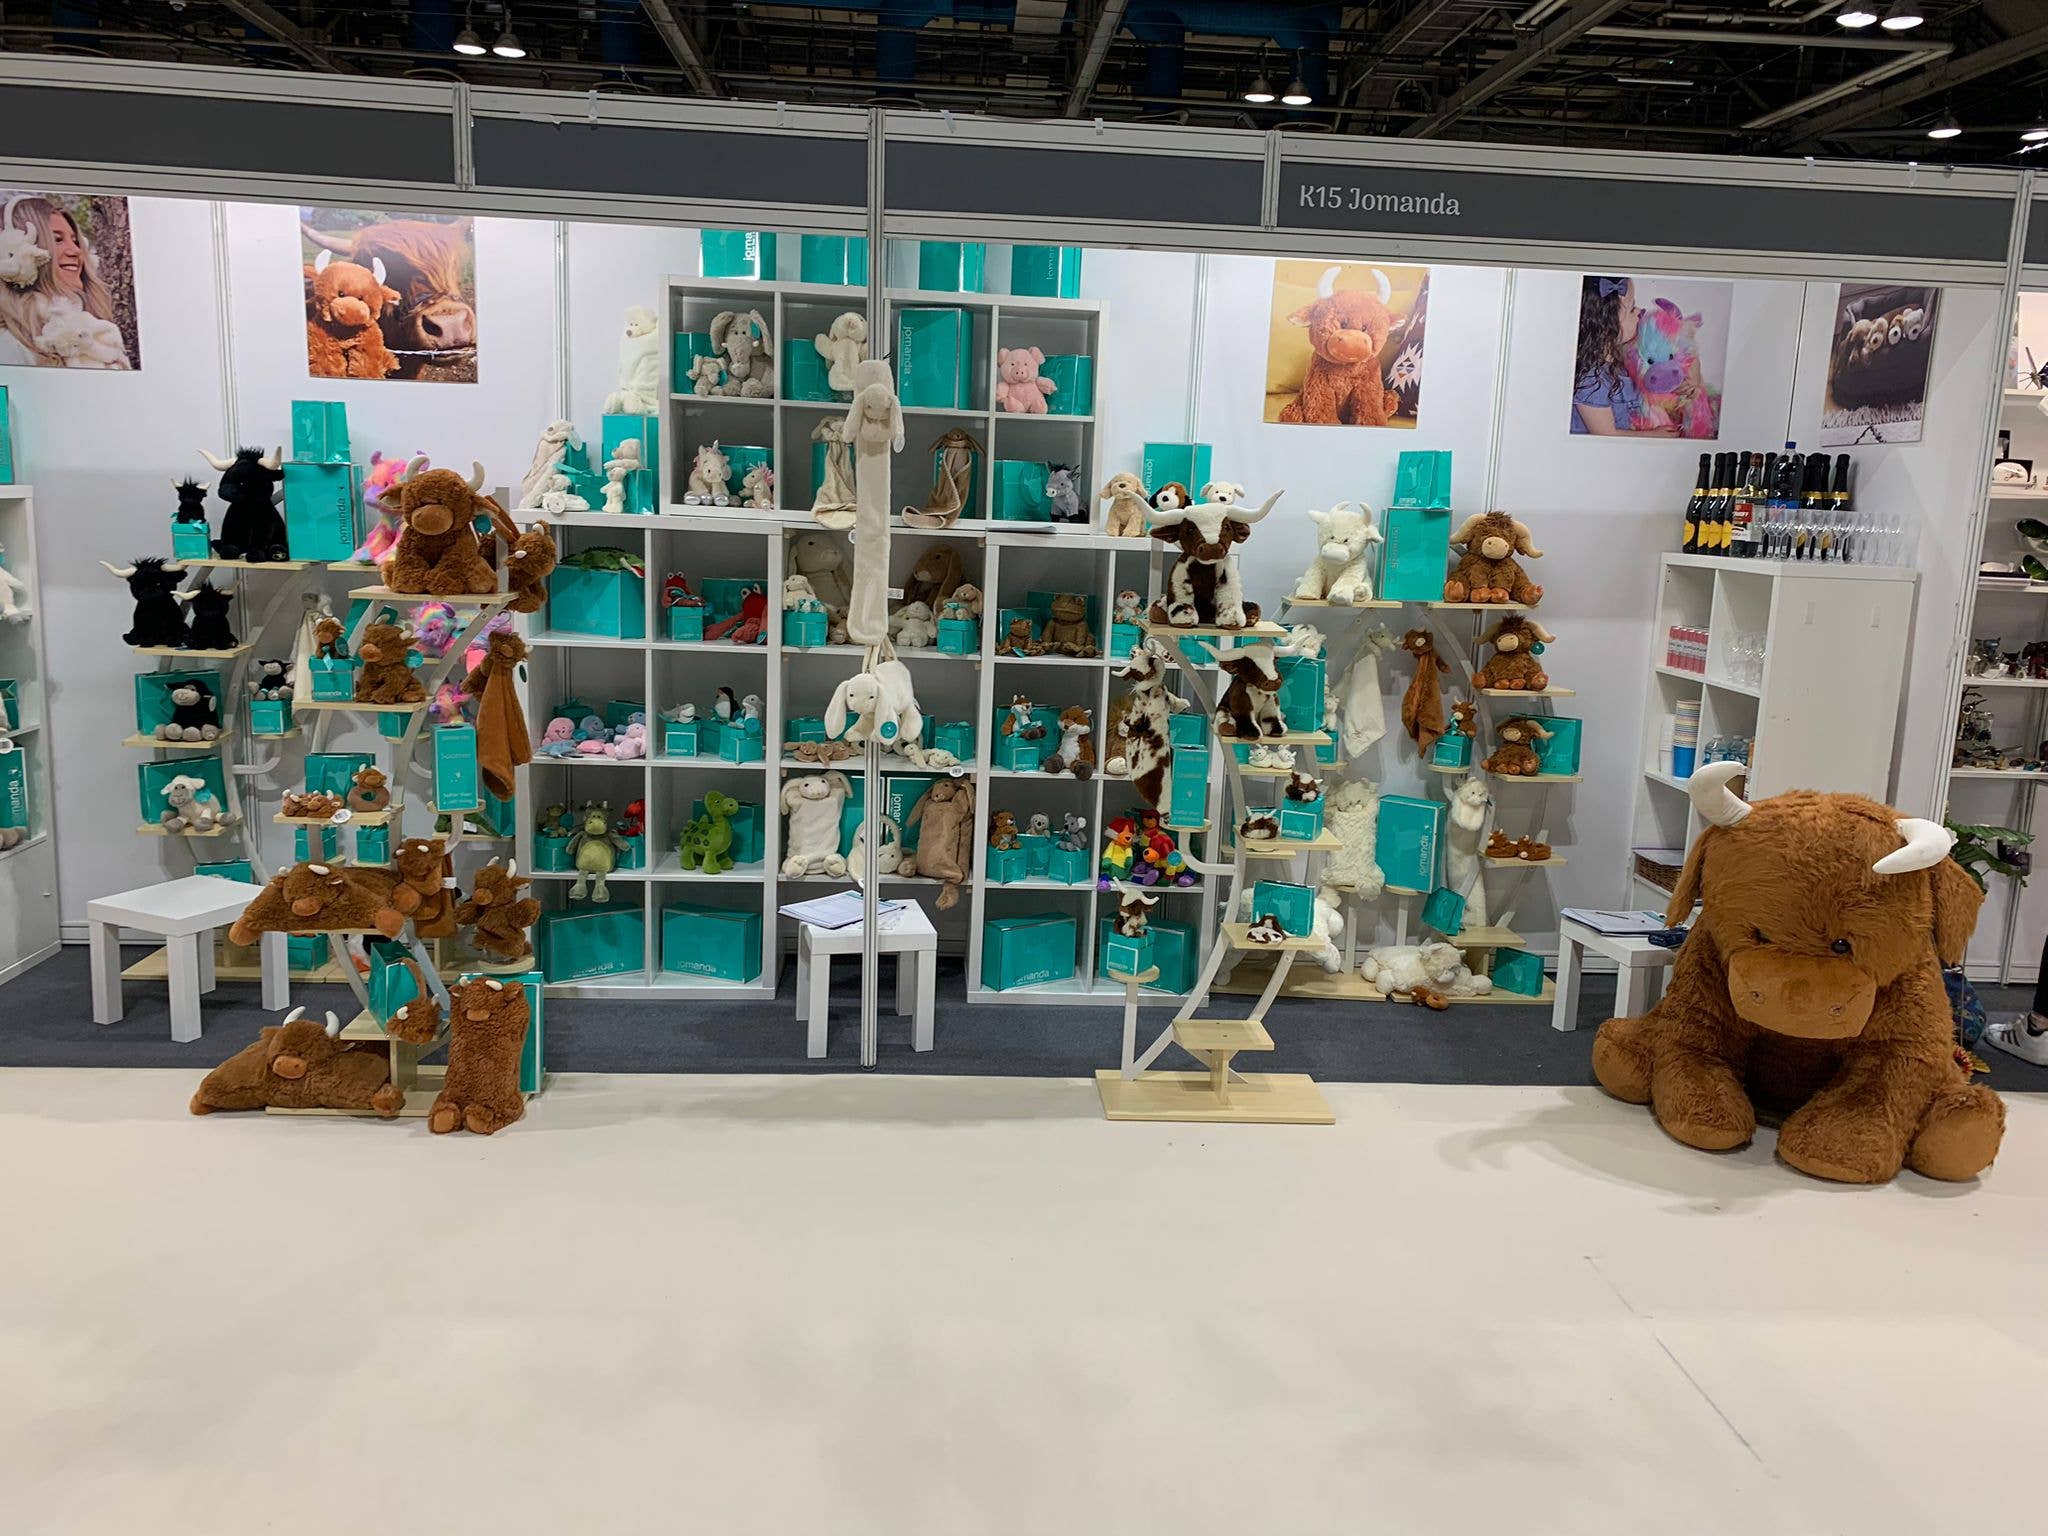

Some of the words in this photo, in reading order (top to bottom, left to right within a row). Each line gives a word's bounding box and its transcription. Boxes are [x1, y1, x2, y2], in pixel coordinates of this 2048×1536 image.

[1300, 184, 1342, 209] K15
[1349, 187, 1461, 216] Jomanda
[903, 326, 914, 375] jomanda
